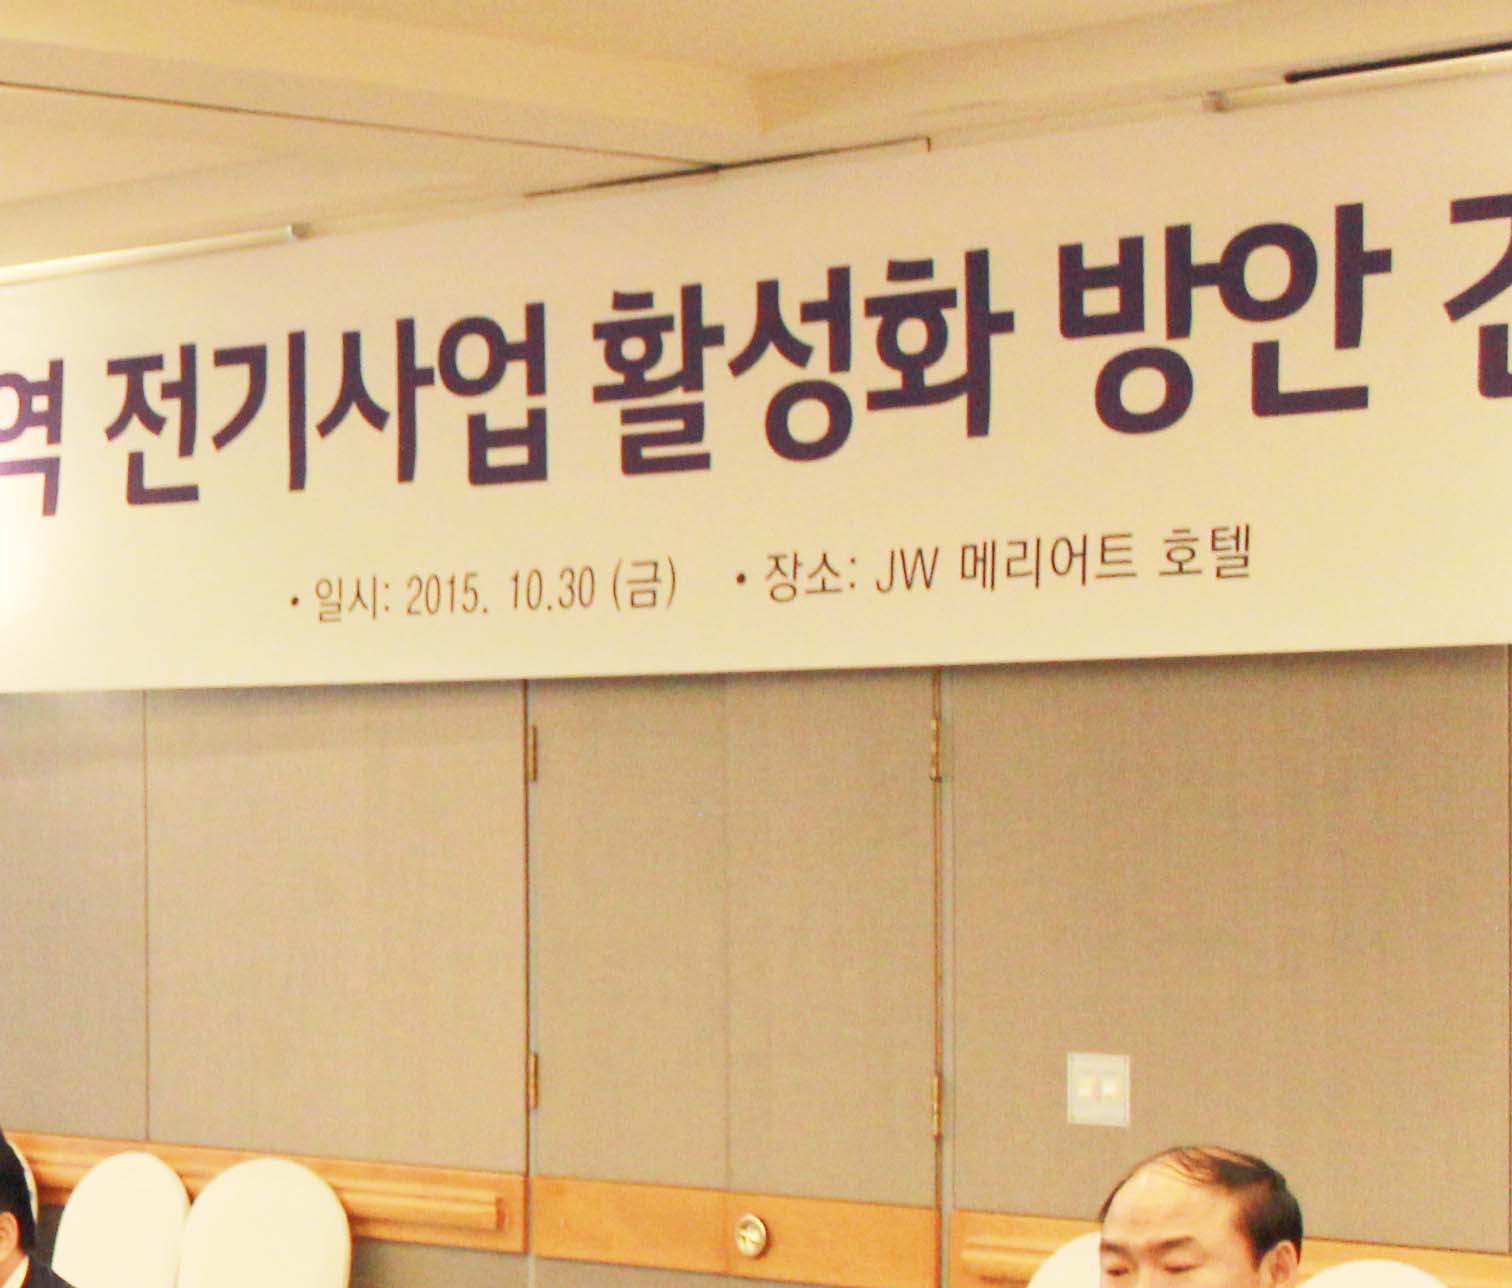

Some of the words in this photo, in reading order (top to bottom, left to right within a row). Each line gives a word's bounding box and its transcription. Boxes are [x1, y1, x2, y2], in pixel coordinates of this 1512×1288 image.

[103, 302, 549, 506] 전기사업
[589, 248, 1016, 476] 활성화
[1057, 202, 1393, 435] 방안
[314, 574, 390, 623] 일시:
[405, 571, 489, 616] 2015.
[509, 565, 596, 612] 10.30
[611, 554, 678, 613] (금)
[763, 549, 858, 604] 장소:
[874, 545, 941, 594] JW
[959, 531, 1138, 593] 메리어트
[1157, 522, 1252, 582] 호텔
